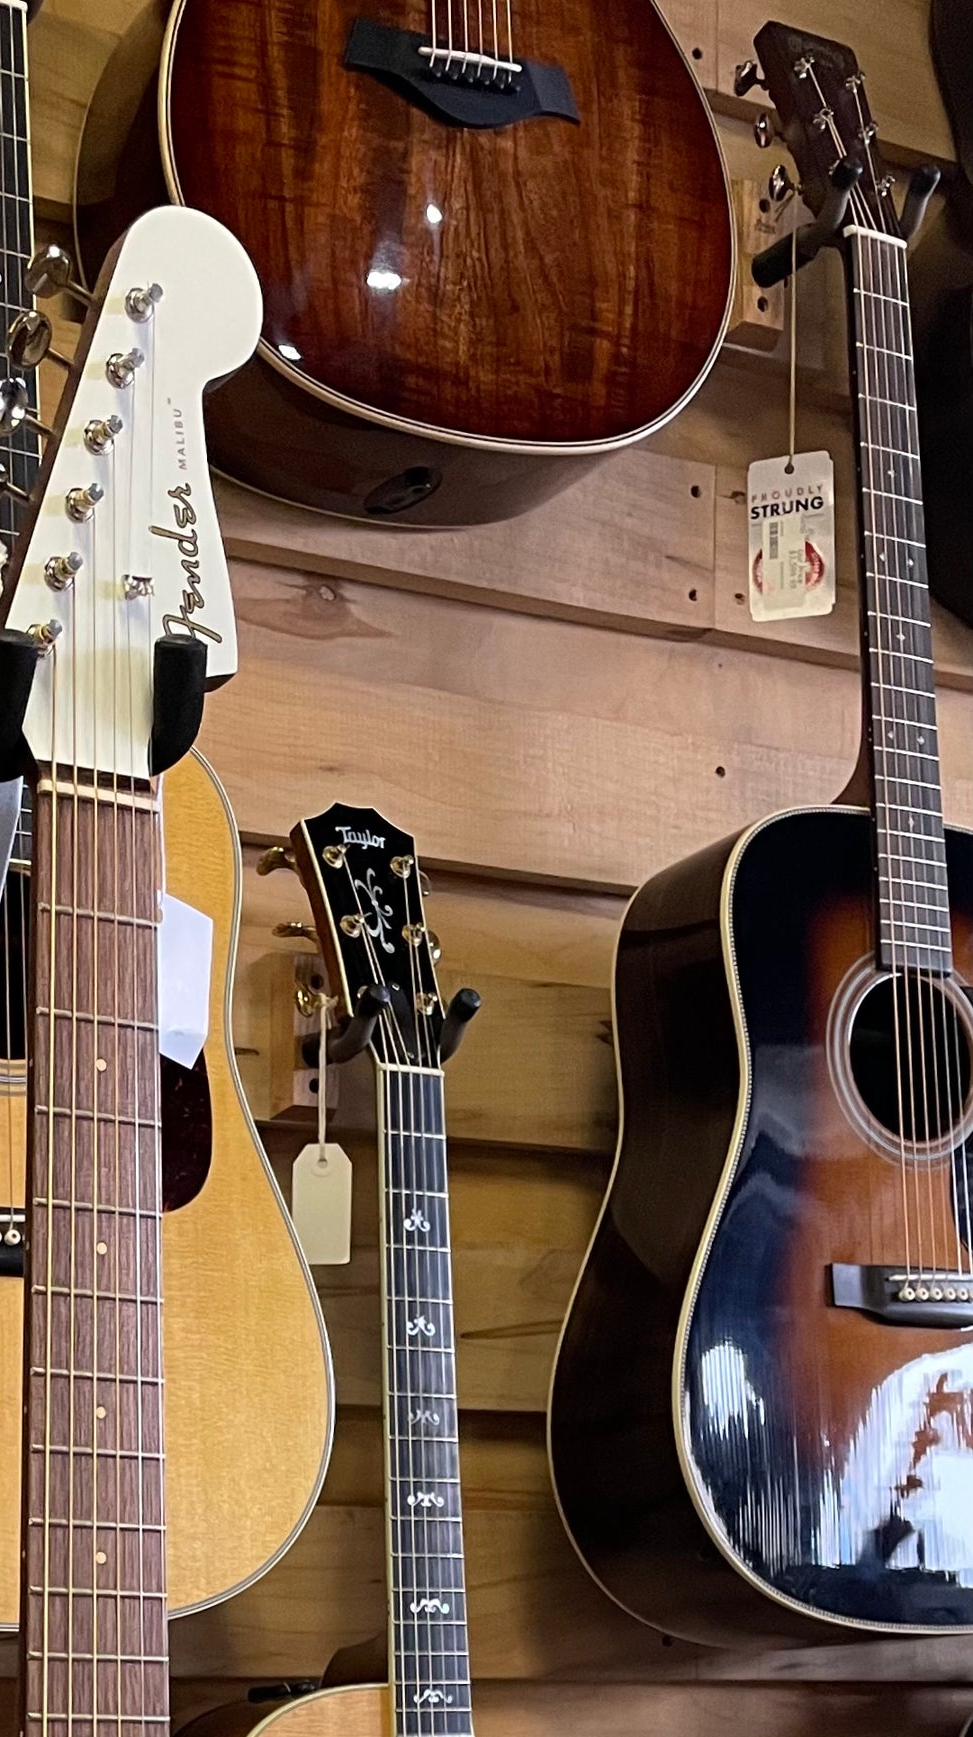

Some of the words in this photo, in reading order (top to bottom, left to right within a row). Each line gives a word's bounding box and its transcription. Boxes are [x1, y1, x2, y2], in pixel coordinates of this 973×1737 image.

[177, 407, 189, 471] MALIBU
[751, 485, 823, 503] PROUDLY
[750, 496, 824, 520] STRUNG
[149, 482, 223, 645] Fender
[335, 826, 386, 849] Taylor
